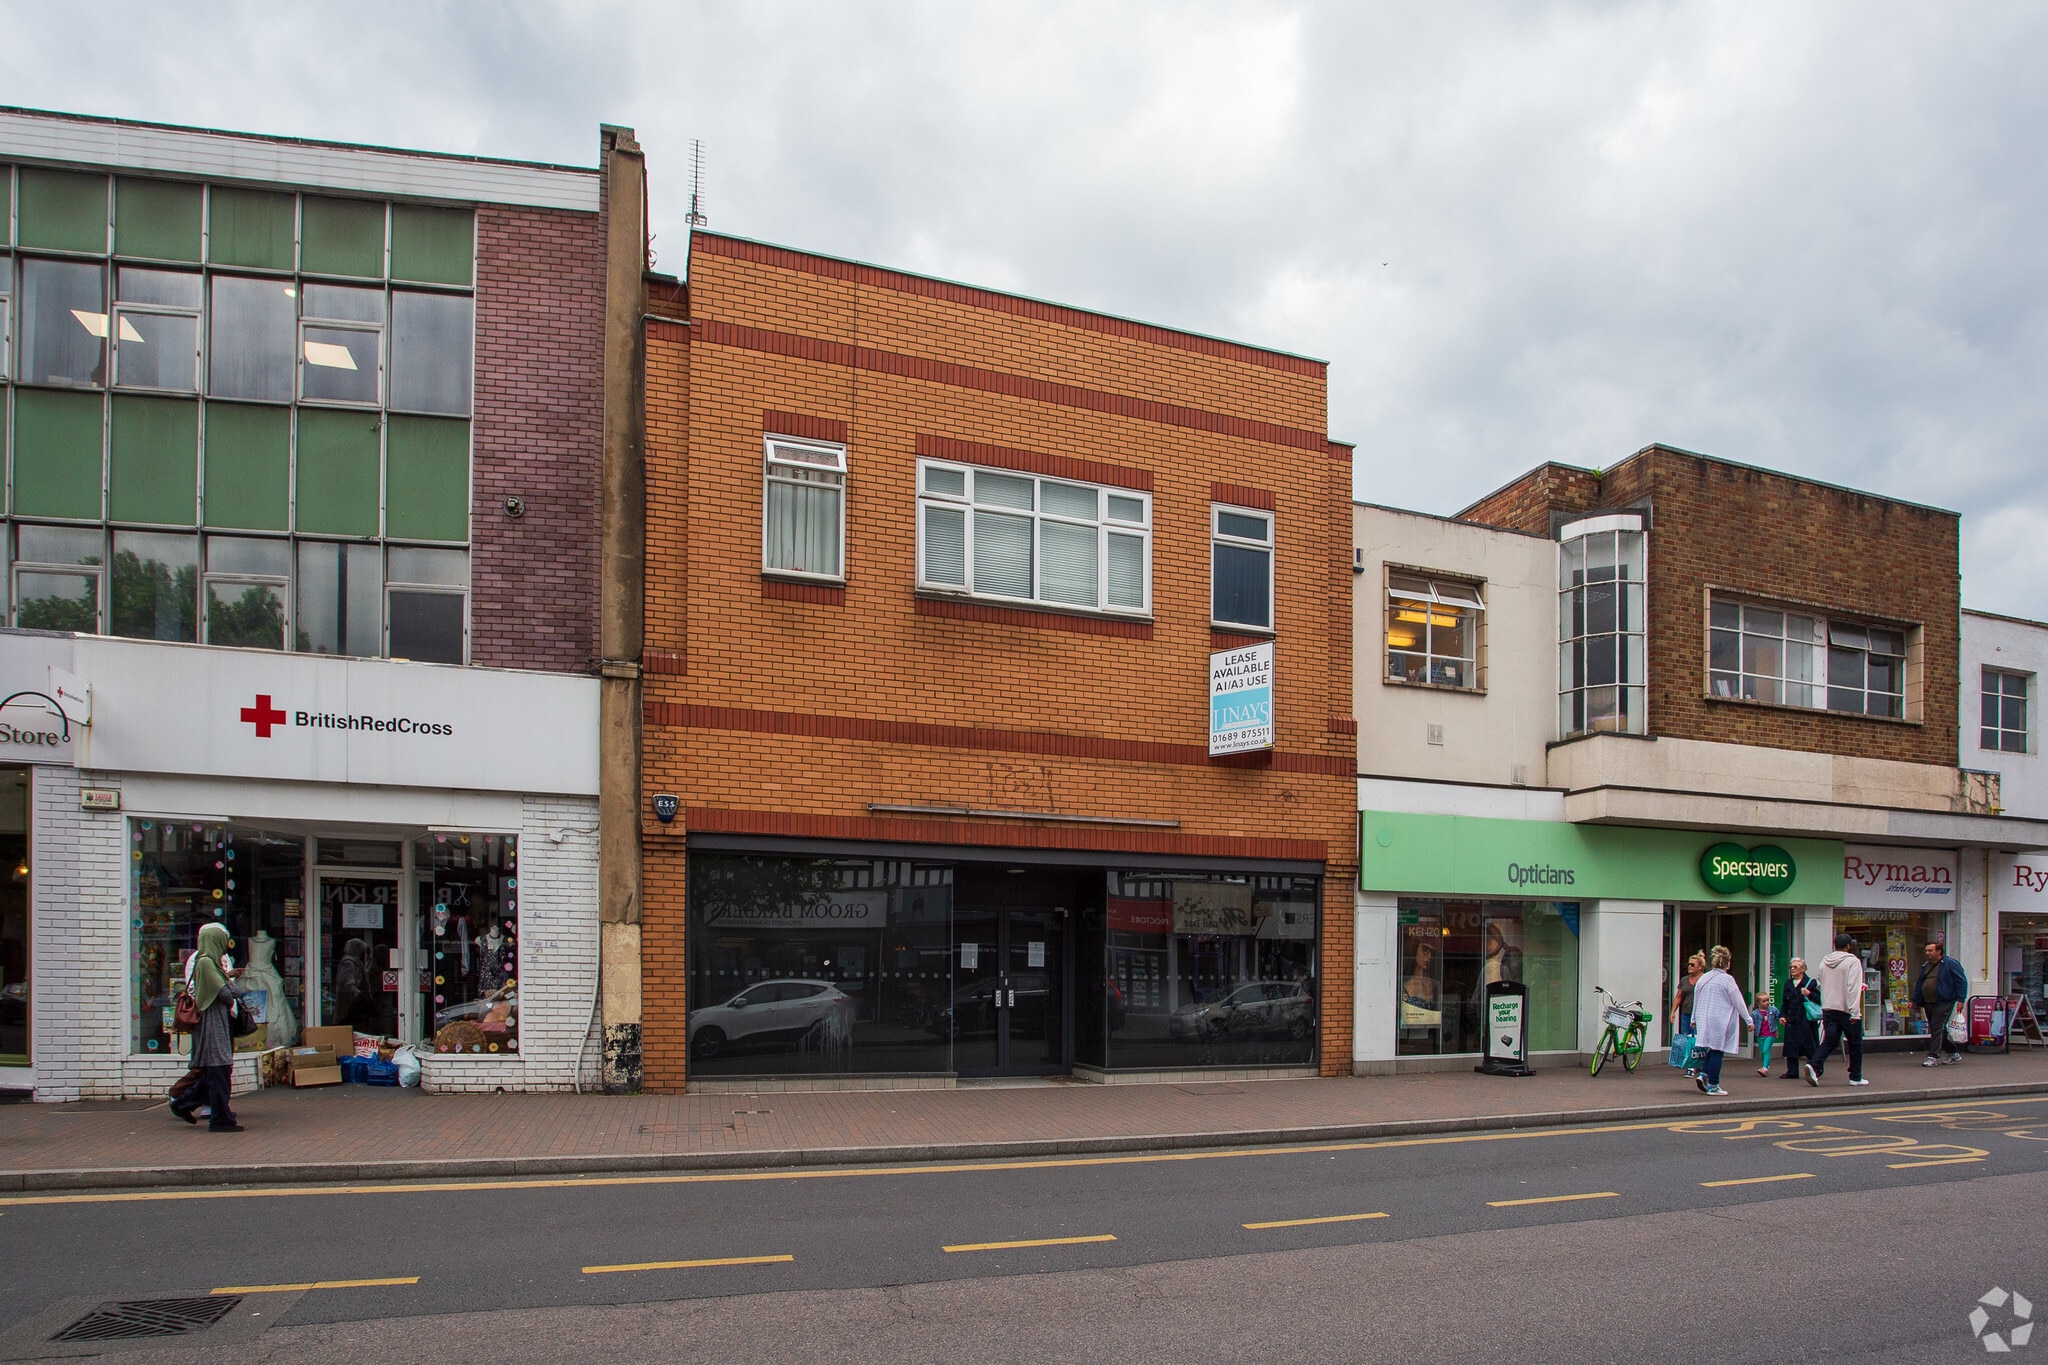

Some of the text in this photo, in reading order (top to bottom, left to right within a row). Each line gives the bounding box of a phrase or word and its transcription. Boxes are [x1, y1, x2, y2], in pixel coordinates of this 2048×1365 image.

[1225, 651, 1257, 666] LEASE
[1213, 660, 1270, 680] AVAILABLE
[1246, 675, 1267, 687] USE
[295, 711, 453, 736] BritishRedCross
[1213, 701, 1269, 731] LINAYS
[0, 723, 59, 746] Store
[1212, 727, 1270, 743] 01689 875511
[1213, 737, 1268, 750] www.linays.co.uk
[658, 800, 675, 808] ESS
[1508, 863, 1575, 888] Opticians
[1712, 856, 1788, 880] Specsavers
[1843, 856, 1953, 886] Ryman
[1408, 926, 1440, 938] KENZO
[1492, 1002, 1519, 1010] Recharge
[1495, 1015, 1517, 1023] hearing
